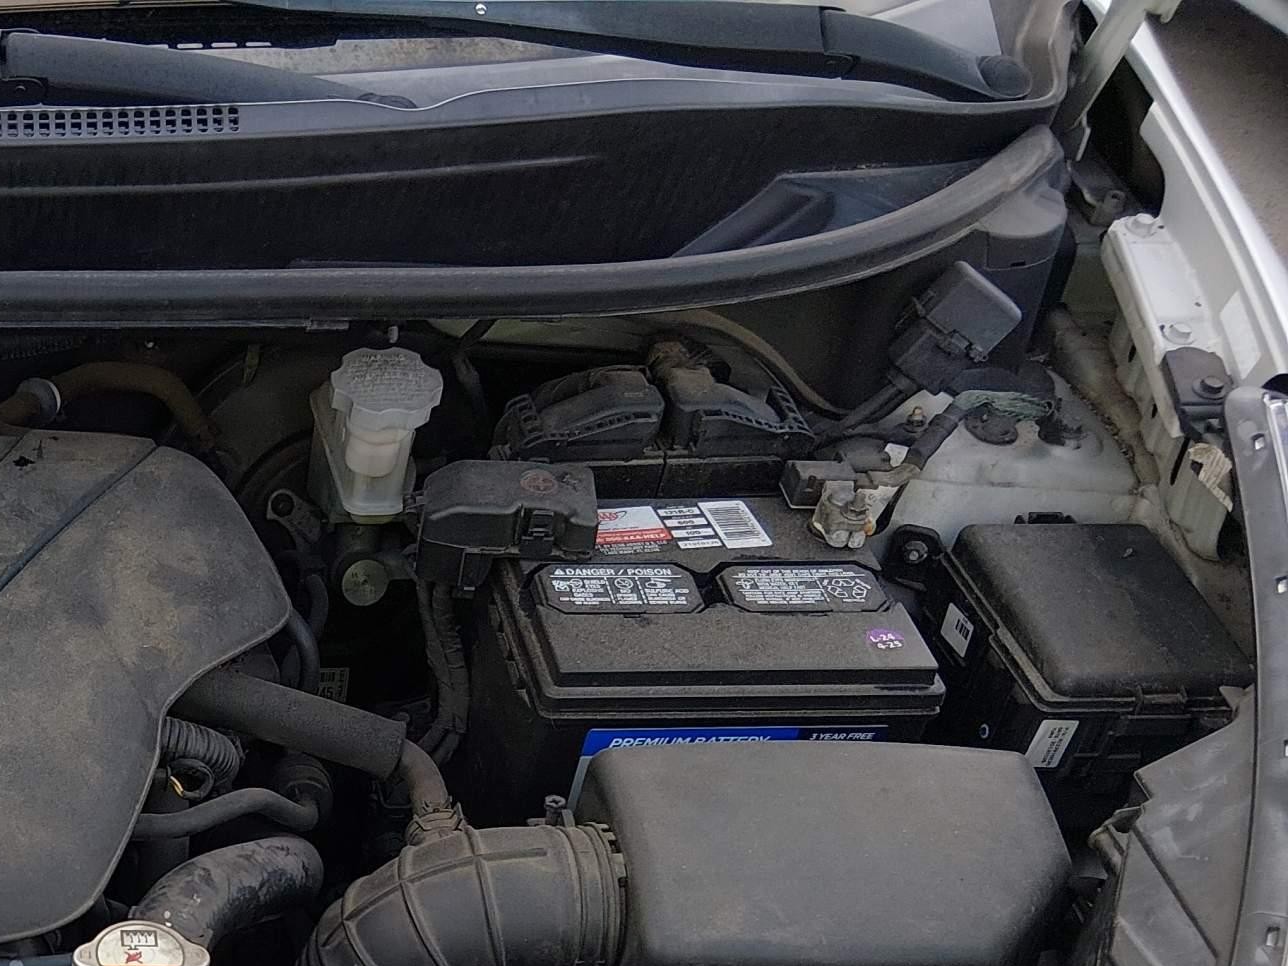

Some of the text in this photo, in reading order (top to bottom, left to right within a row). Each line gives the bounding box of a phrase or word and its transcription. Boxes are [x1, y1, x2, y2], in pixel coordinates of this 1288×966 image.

[565, 568, 673, 576] DANGER / POISON
[847, 732, 876, 740] FREE
